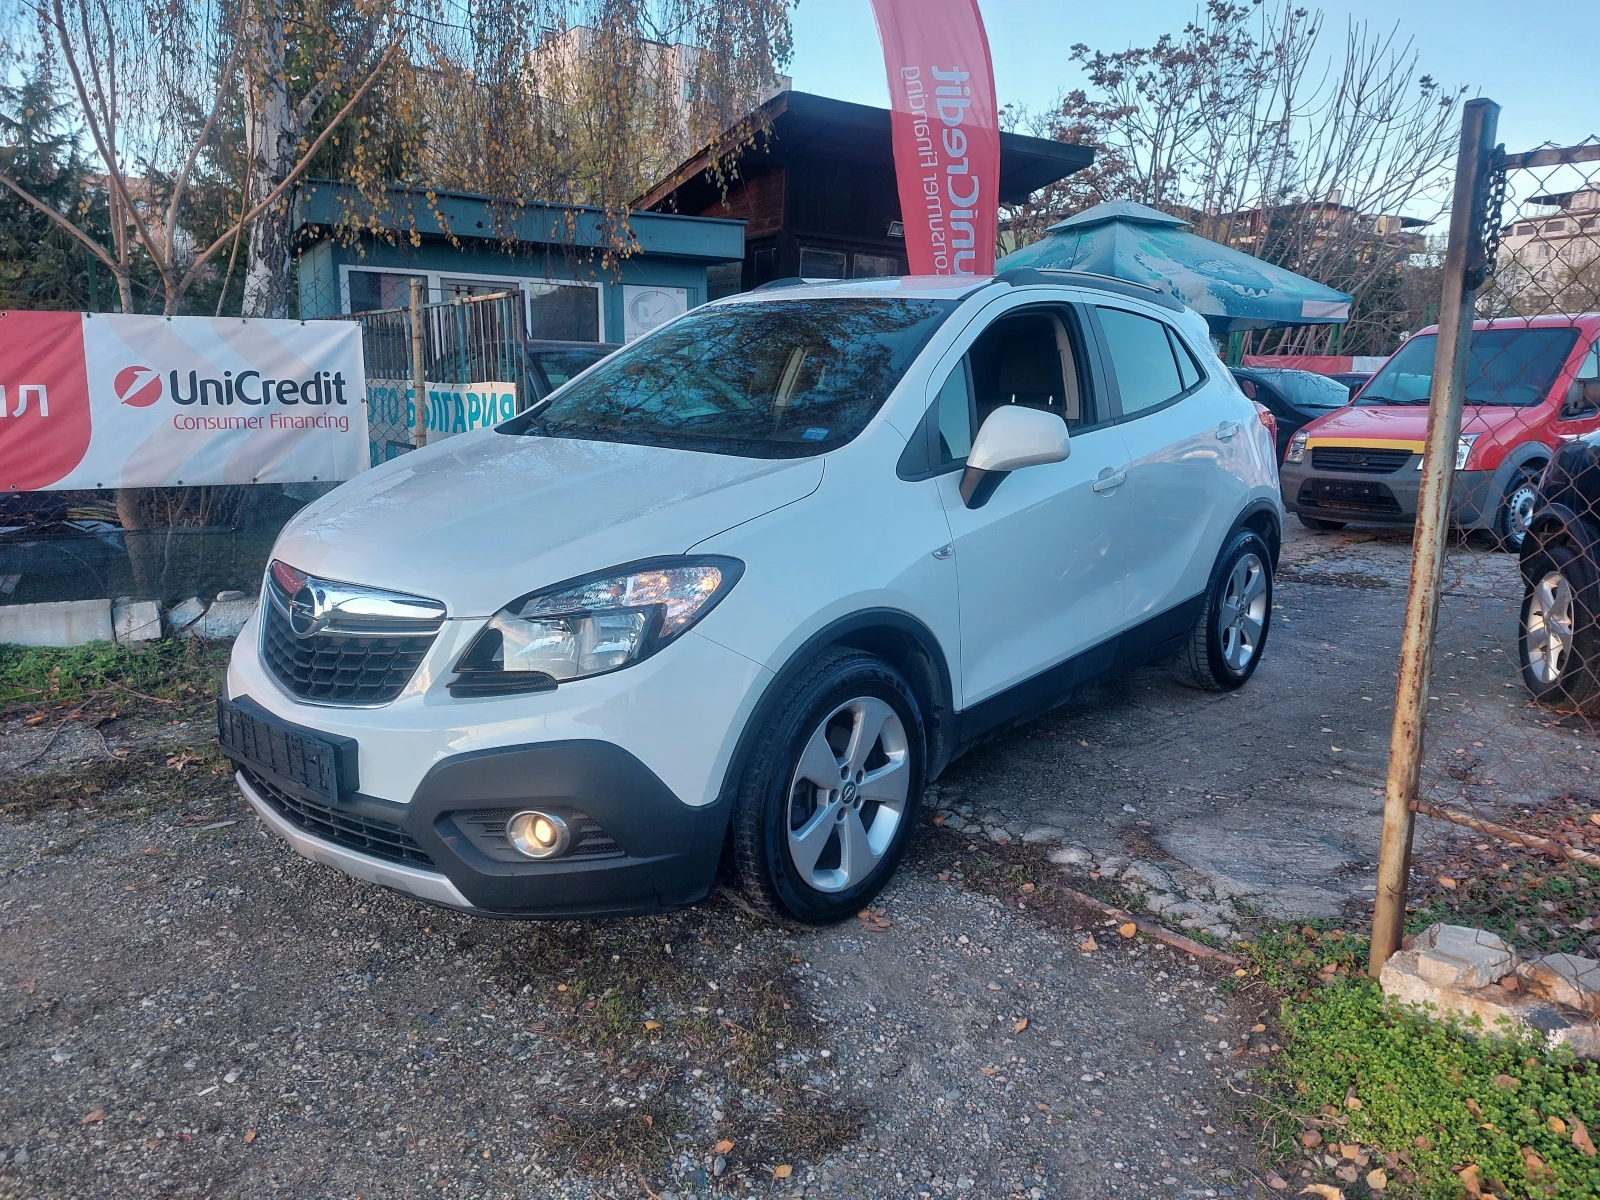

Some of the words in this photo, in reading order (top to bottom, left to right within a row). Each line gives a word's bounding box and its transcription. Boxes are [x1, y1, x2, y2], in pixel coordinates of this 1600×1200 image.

[169, 369, 347, 406] UniCredit
[173, 413, 265, 430] Consumer
[269, 412, 349, 433] Financing
